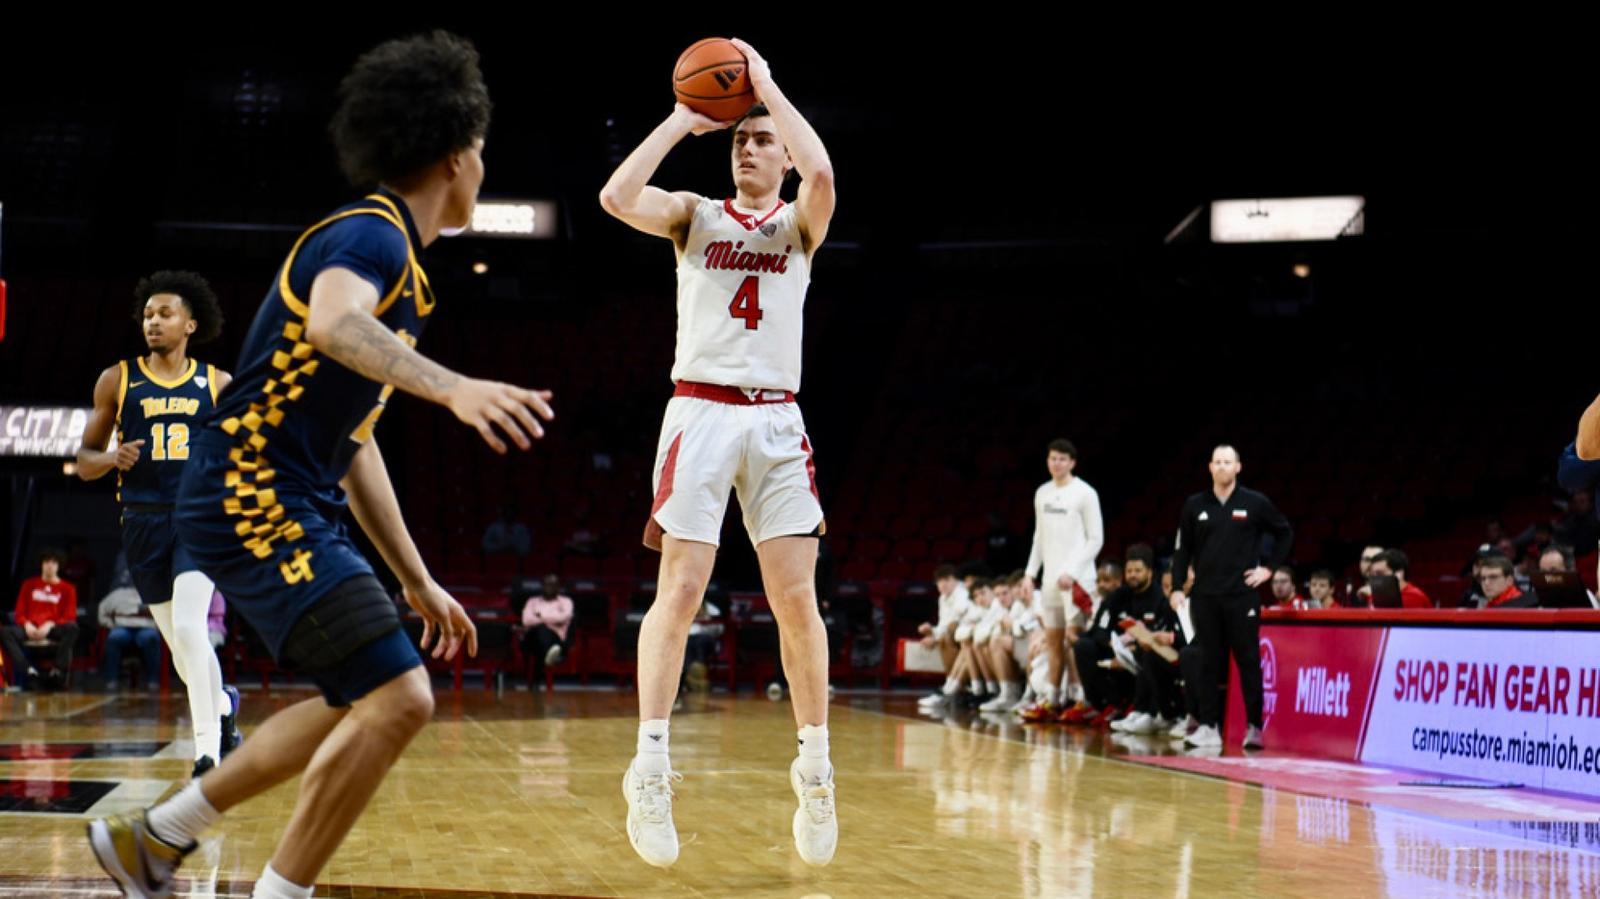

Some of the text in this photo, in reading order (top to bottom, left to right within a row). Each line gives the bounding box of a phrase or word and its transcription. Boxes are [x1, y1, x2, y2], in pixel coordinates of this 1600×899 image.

[704, 241, 792, 274] Miami
[728, 275, 763, 330] 4
[5, 408, 63, 438] CITY
[140, 397, 200, 418] TOLEDO
[151, 422, 190, 460] 12
[1295, 666, 1350, 718] Millett
[1394, 659, 1449, 704] SHOP
[1453, 662, 1498, 709] FAN
[1504, 664, 1570, 715] GEAR
